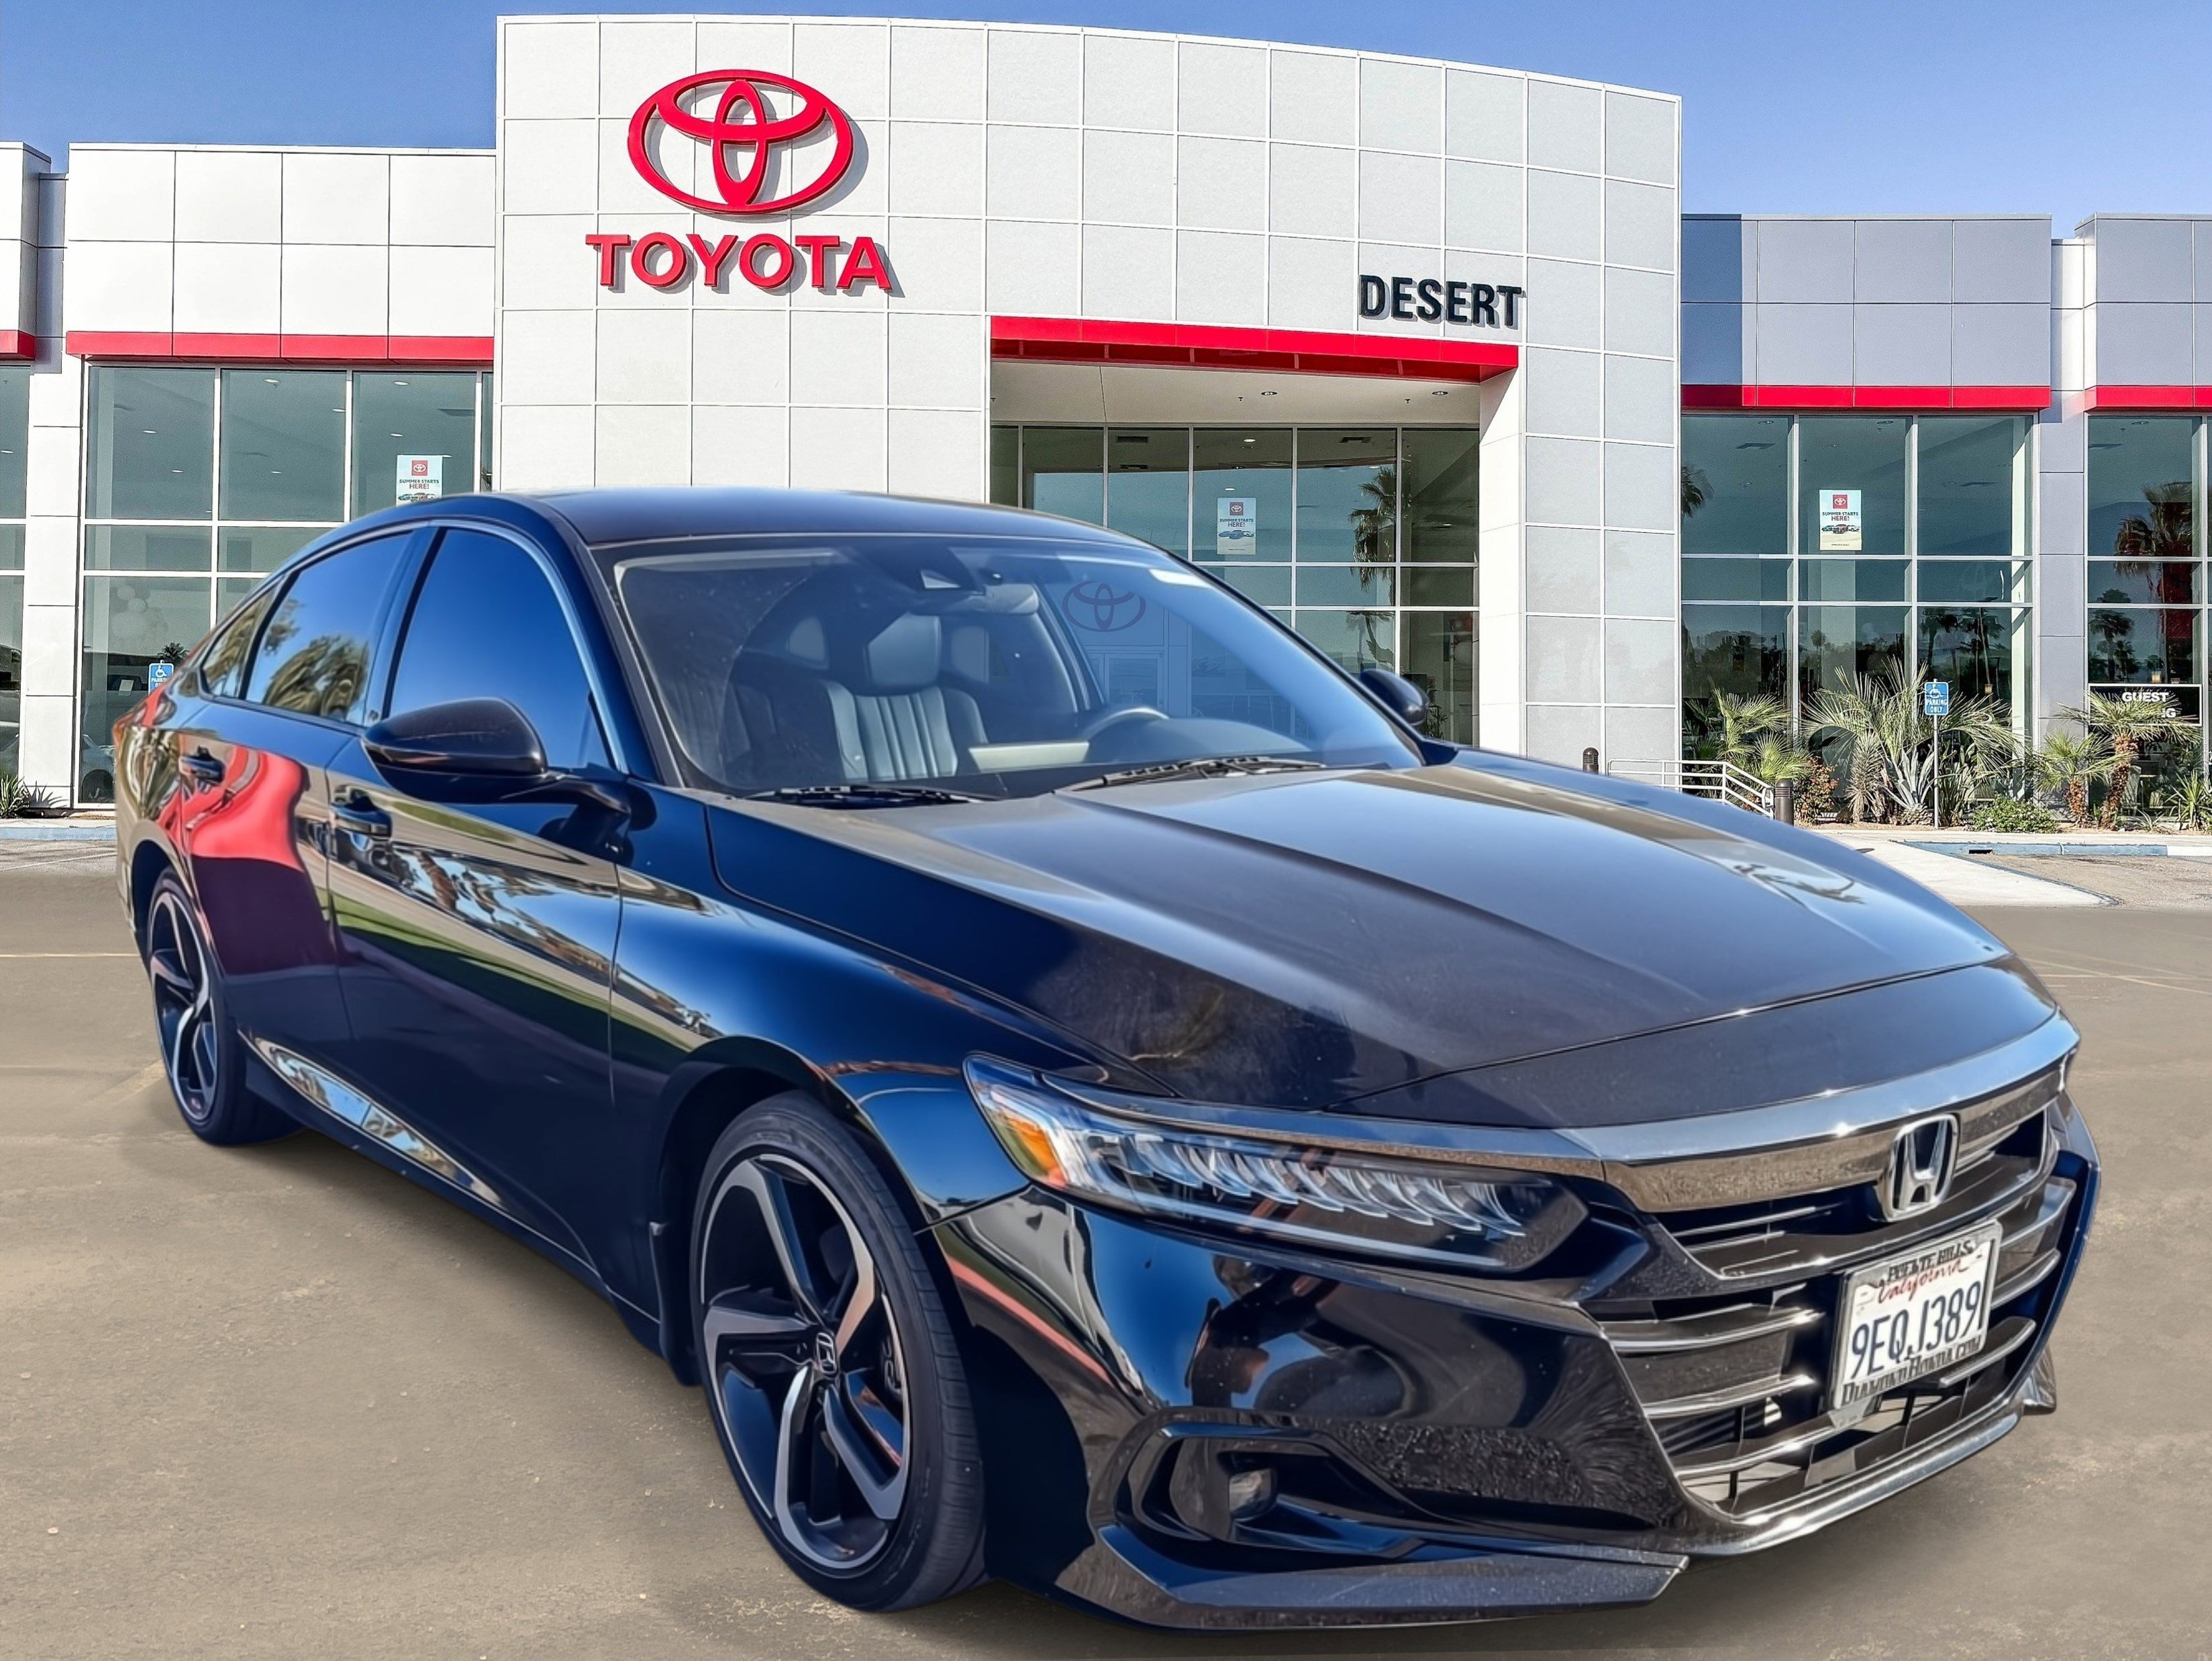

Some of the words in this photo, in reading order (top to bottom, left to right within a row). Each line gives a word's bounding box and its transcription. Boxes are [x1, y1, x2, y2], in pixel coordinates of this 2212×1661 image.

[585, 232, 891, 291] TOYOTA
[1359, 274, 1522, 327] DESERT
[2121, 691, 2170, 703] GUEST
